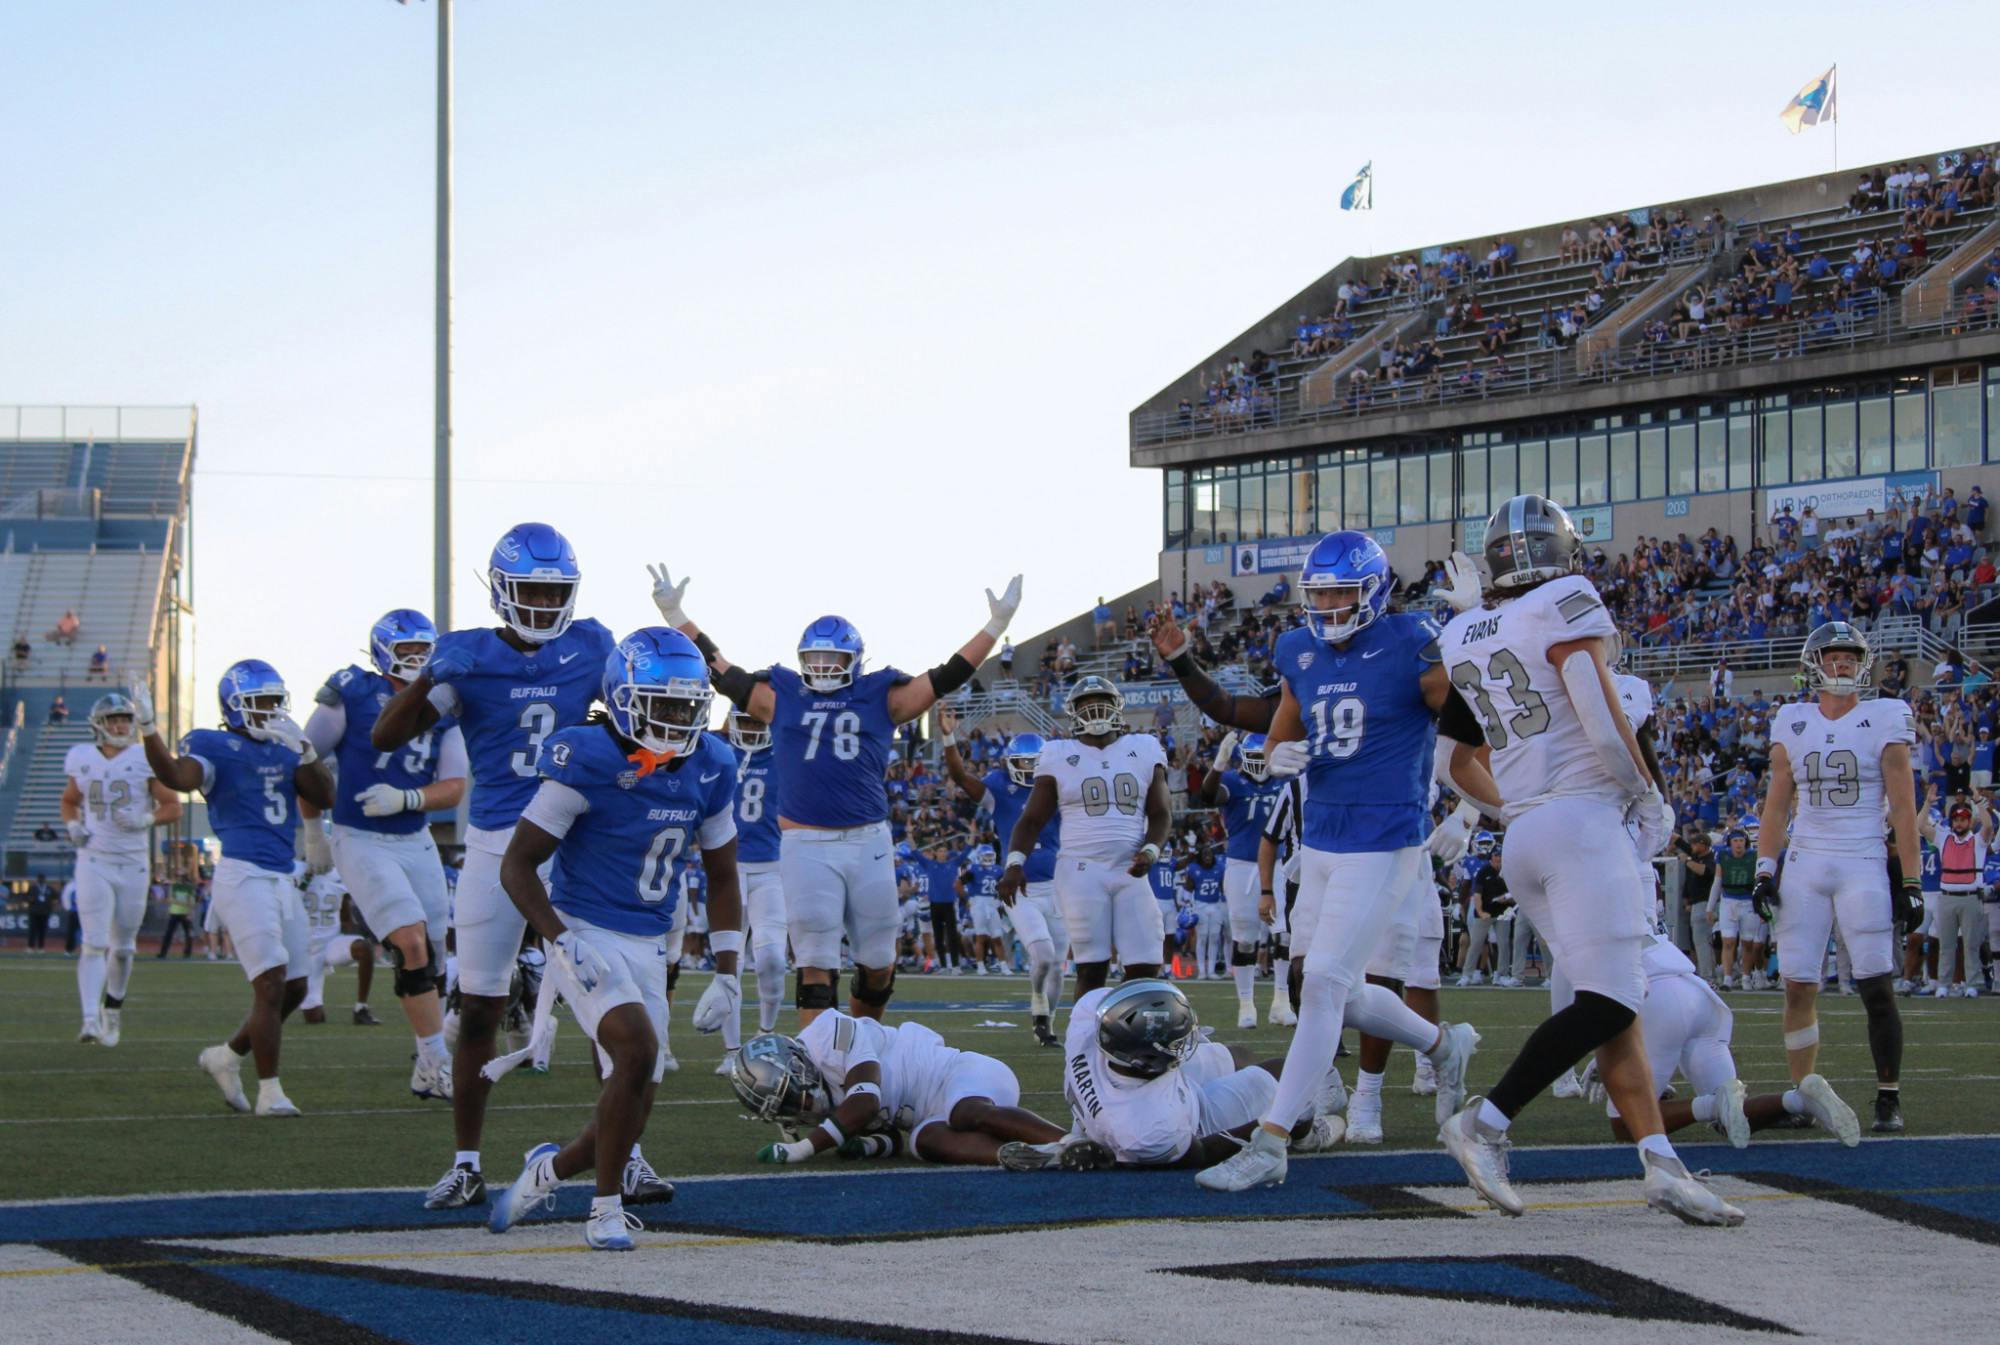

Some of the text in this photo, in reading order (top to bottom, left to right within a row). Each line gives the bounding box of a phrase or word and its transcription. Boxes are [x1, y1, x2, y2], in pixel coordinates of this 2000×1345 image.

[1938, 152, 1961, 169] 33
[1820, 488, 1883, 503] ORTHOPAEDICS
[1666, 502, 1688, 516] 203
[1376, 531, 1394, 545] 202
[1206, 550, 1222, 563] 201
[1461, 614, 1504, 646] EVANS
[510, 685, 558, 699] BUFFALO
[1316, 681, 1358, 696] BUFFALO
[812, 700, 847, 710] BUFFALO
[1124, 691, 1146, 705] KIDS
[1450, 647, 1552, 751] 33
[800, 711, 861, 762] 78
[1310, 697, 1367, 759] 19
[510, 701, 558, 778] 3
[1825, 733, 1835, 744] E
[1802, 749, 1861, 807] 13
[88, 780, 131, 822] 42
[263, 774, 288, 825] 5
[739, 777, 766, 823] 8
[646, 808, 698, 822] BUFFALO
[635, 826, 688, 905] 0
[1159, 870, 1173, 888] 10
[1199, 882, 1219, 896] 27
[1070, 1053, 1104, 1119] MARTIN
